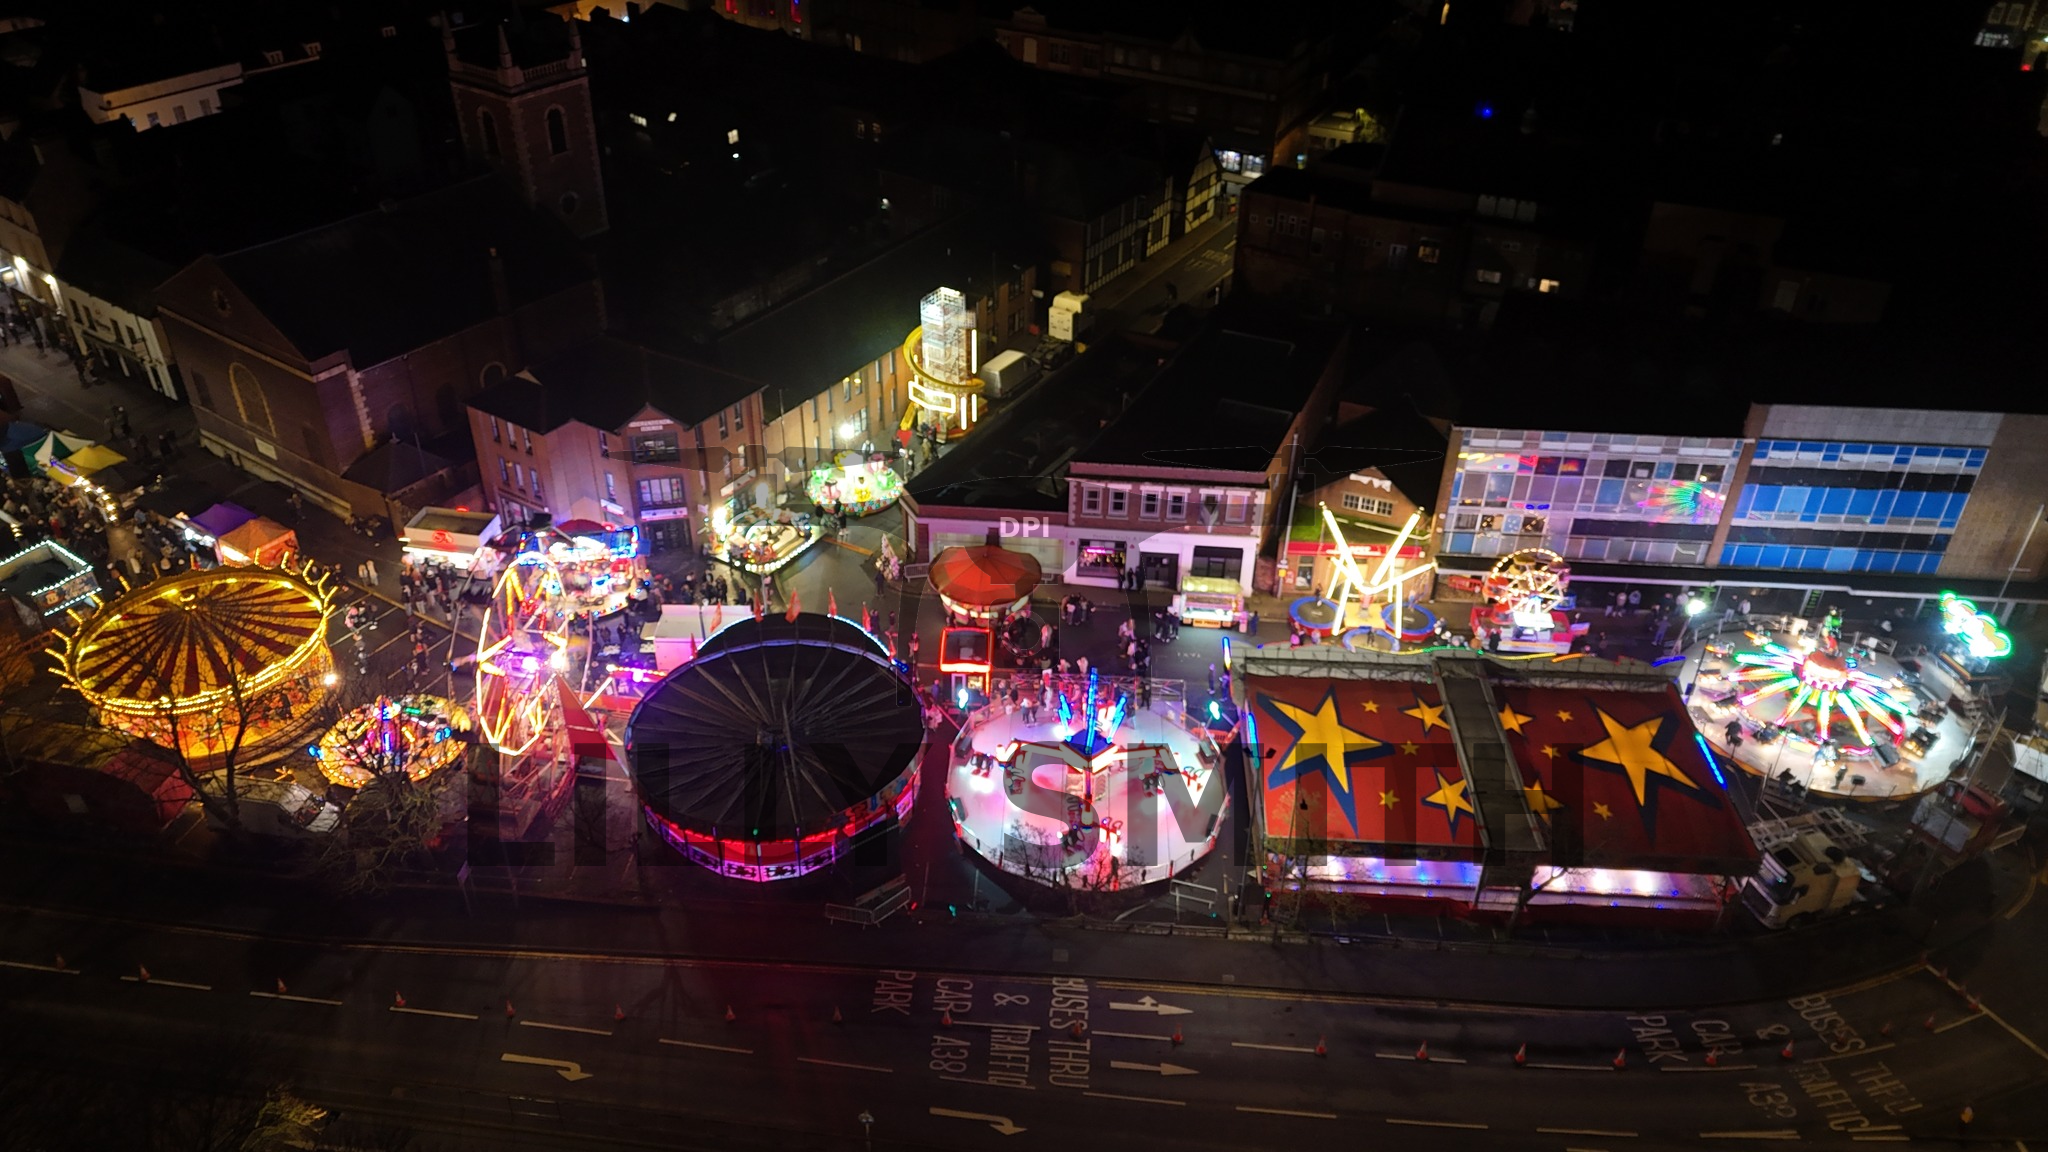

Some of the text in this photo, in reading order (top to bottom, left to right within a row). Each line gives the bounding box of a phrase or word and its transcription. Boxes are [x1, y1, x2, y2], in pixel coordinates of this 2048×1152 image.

[870, 969, 916, 1016] PARK
[932, 976, 974, 1015] CAR
[993, 992, 1030, 1007] &
[1048, 976, 1089, 1032] BUSES
[1626, 1015, 1688, 1063] PARK
[1756, 1023, 1790, 1040] &
[1788, 996, 1867, 1055] BUSES
[929, 1034, 971, 1074] A38
[1048, 1038, 1091, 1089] THRU
